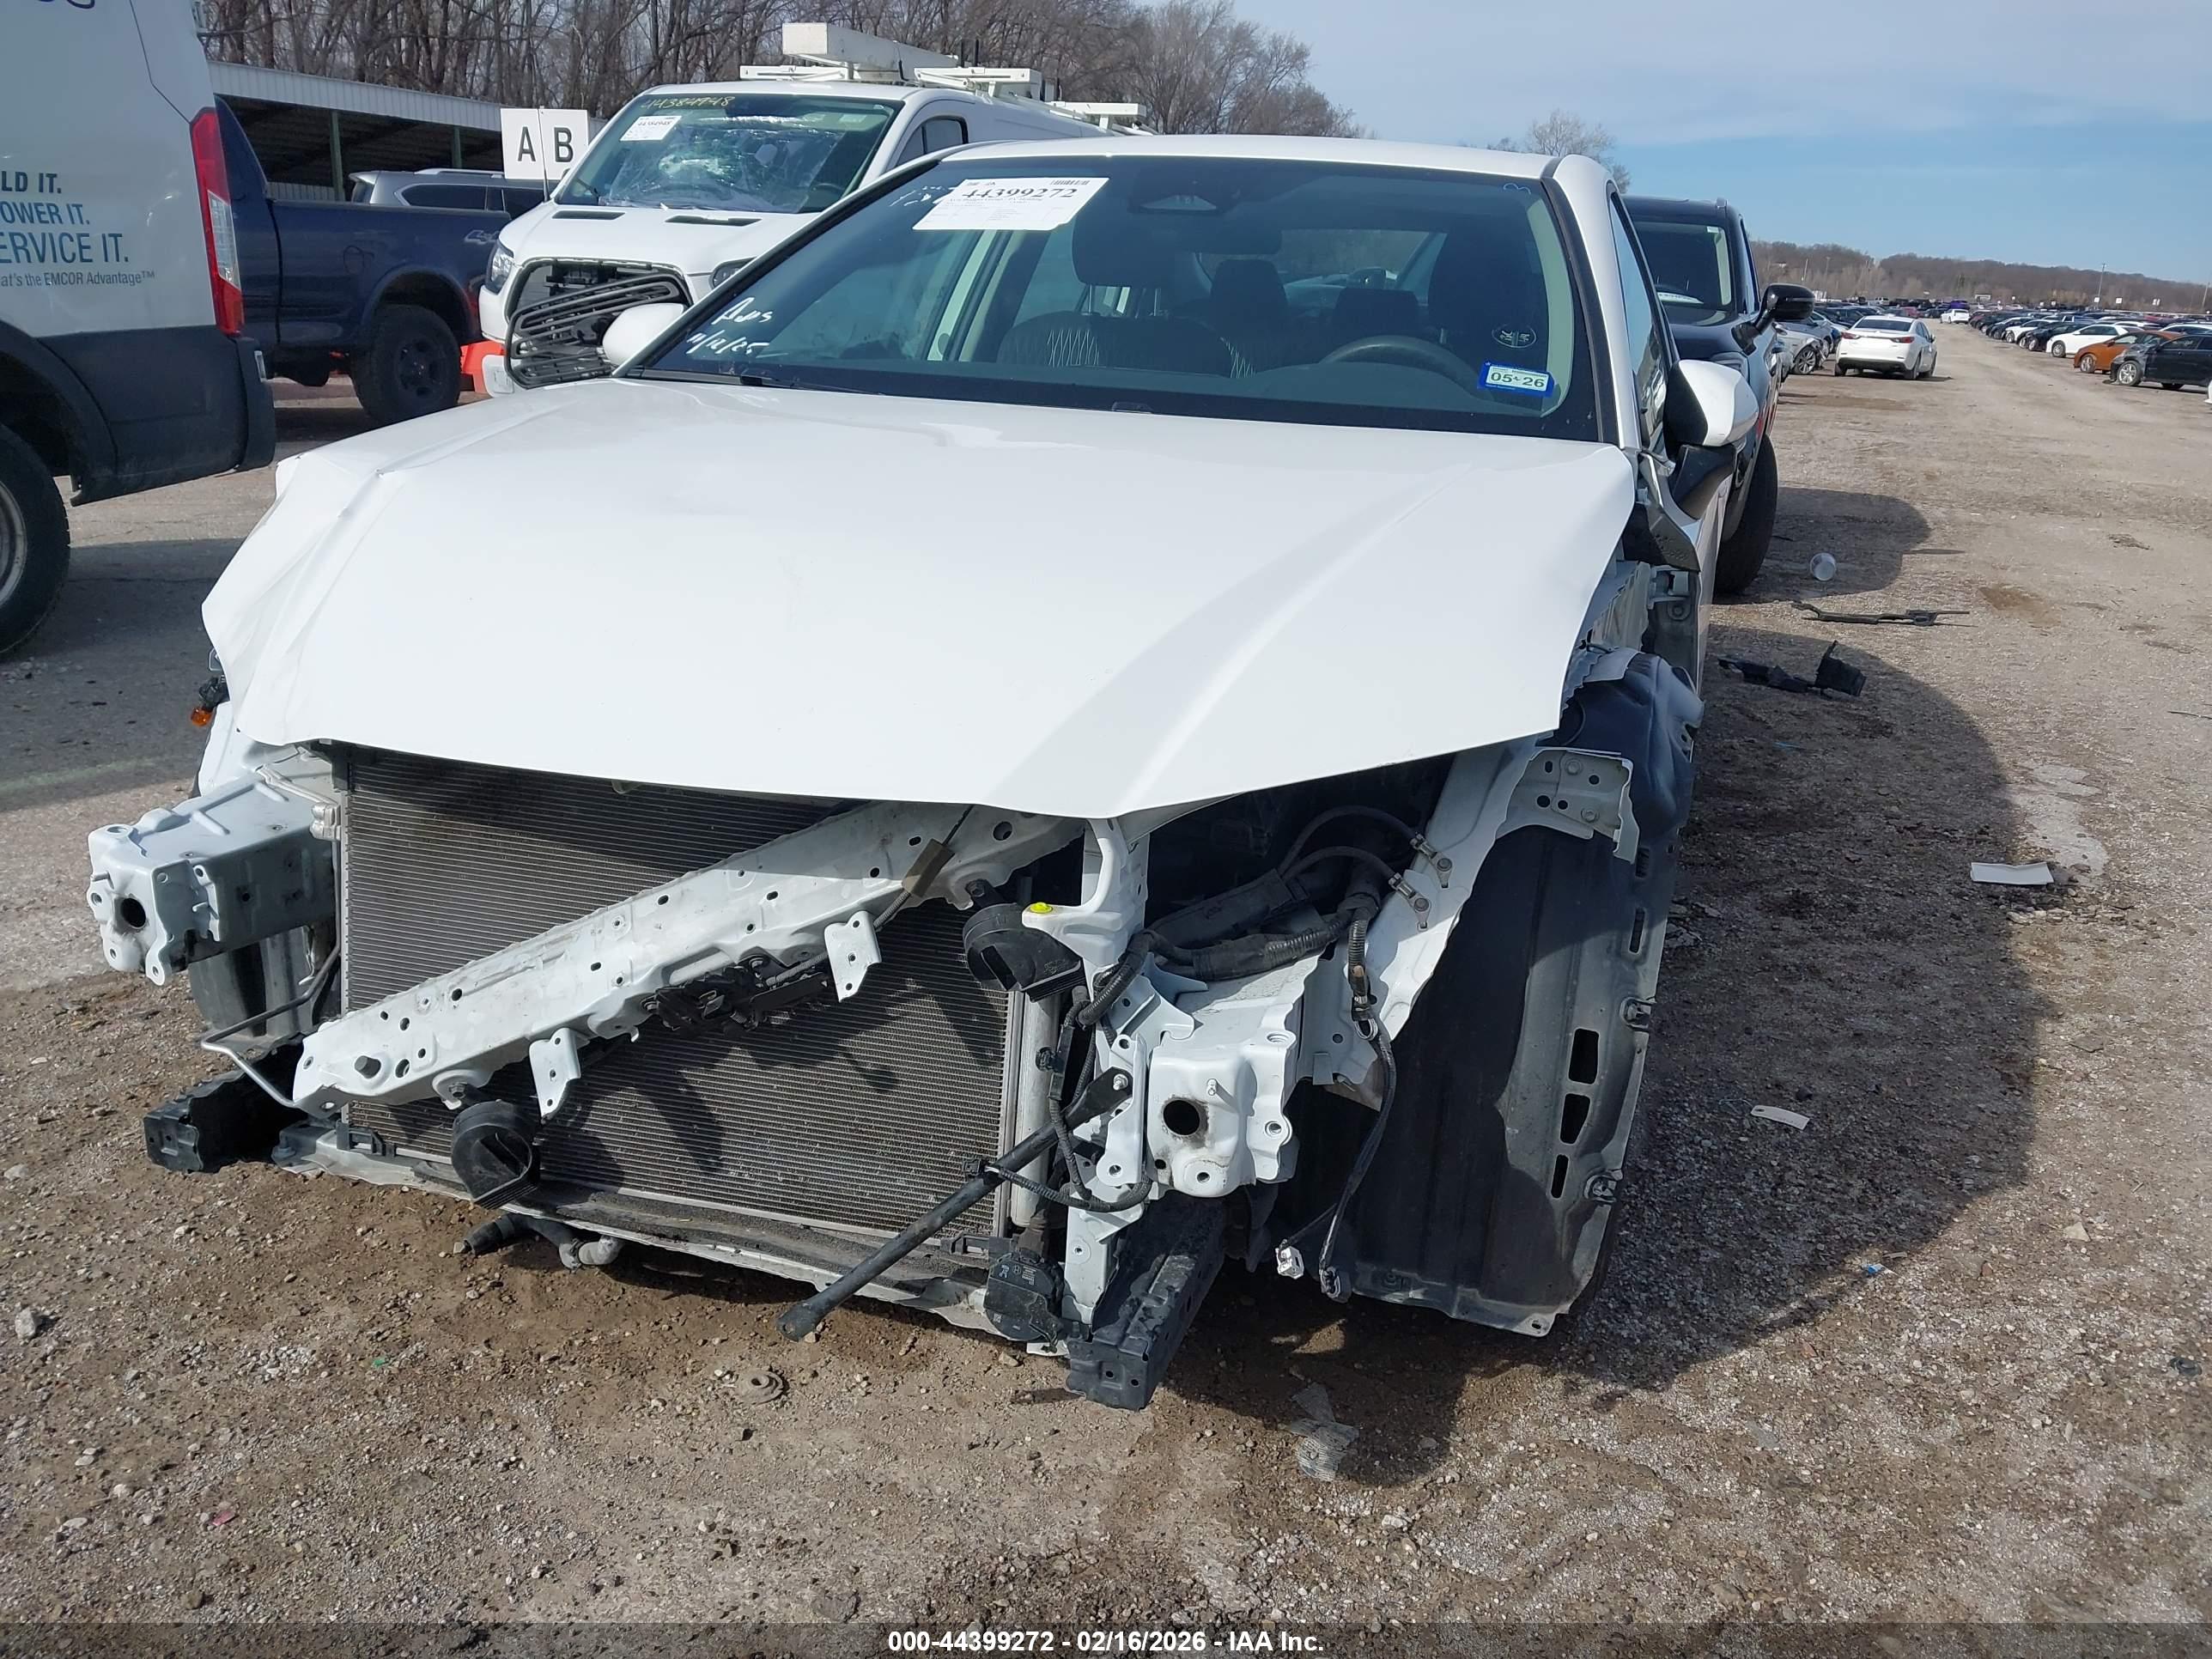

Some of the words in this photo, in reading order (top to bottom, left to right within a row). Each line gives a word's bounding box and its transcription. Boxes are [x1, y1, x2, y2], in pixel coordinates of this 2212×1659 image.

[517, 126, 537, 162] A
[554, 126, 574, 163] B
[38, 173, 63, 194] IT.
[963, 188, 1077, 198] 44399272
[0, 201, 64, 225] OWER
[66, 204, 90, 225] IT.
[101, 233, 130, 263] IT.
[25, 274, 42, 287] the
[44, 271, 83, 286] EMCOR
[1491, 372, 1514, 383] 05
[1522, 376, 1545, 388] 26
